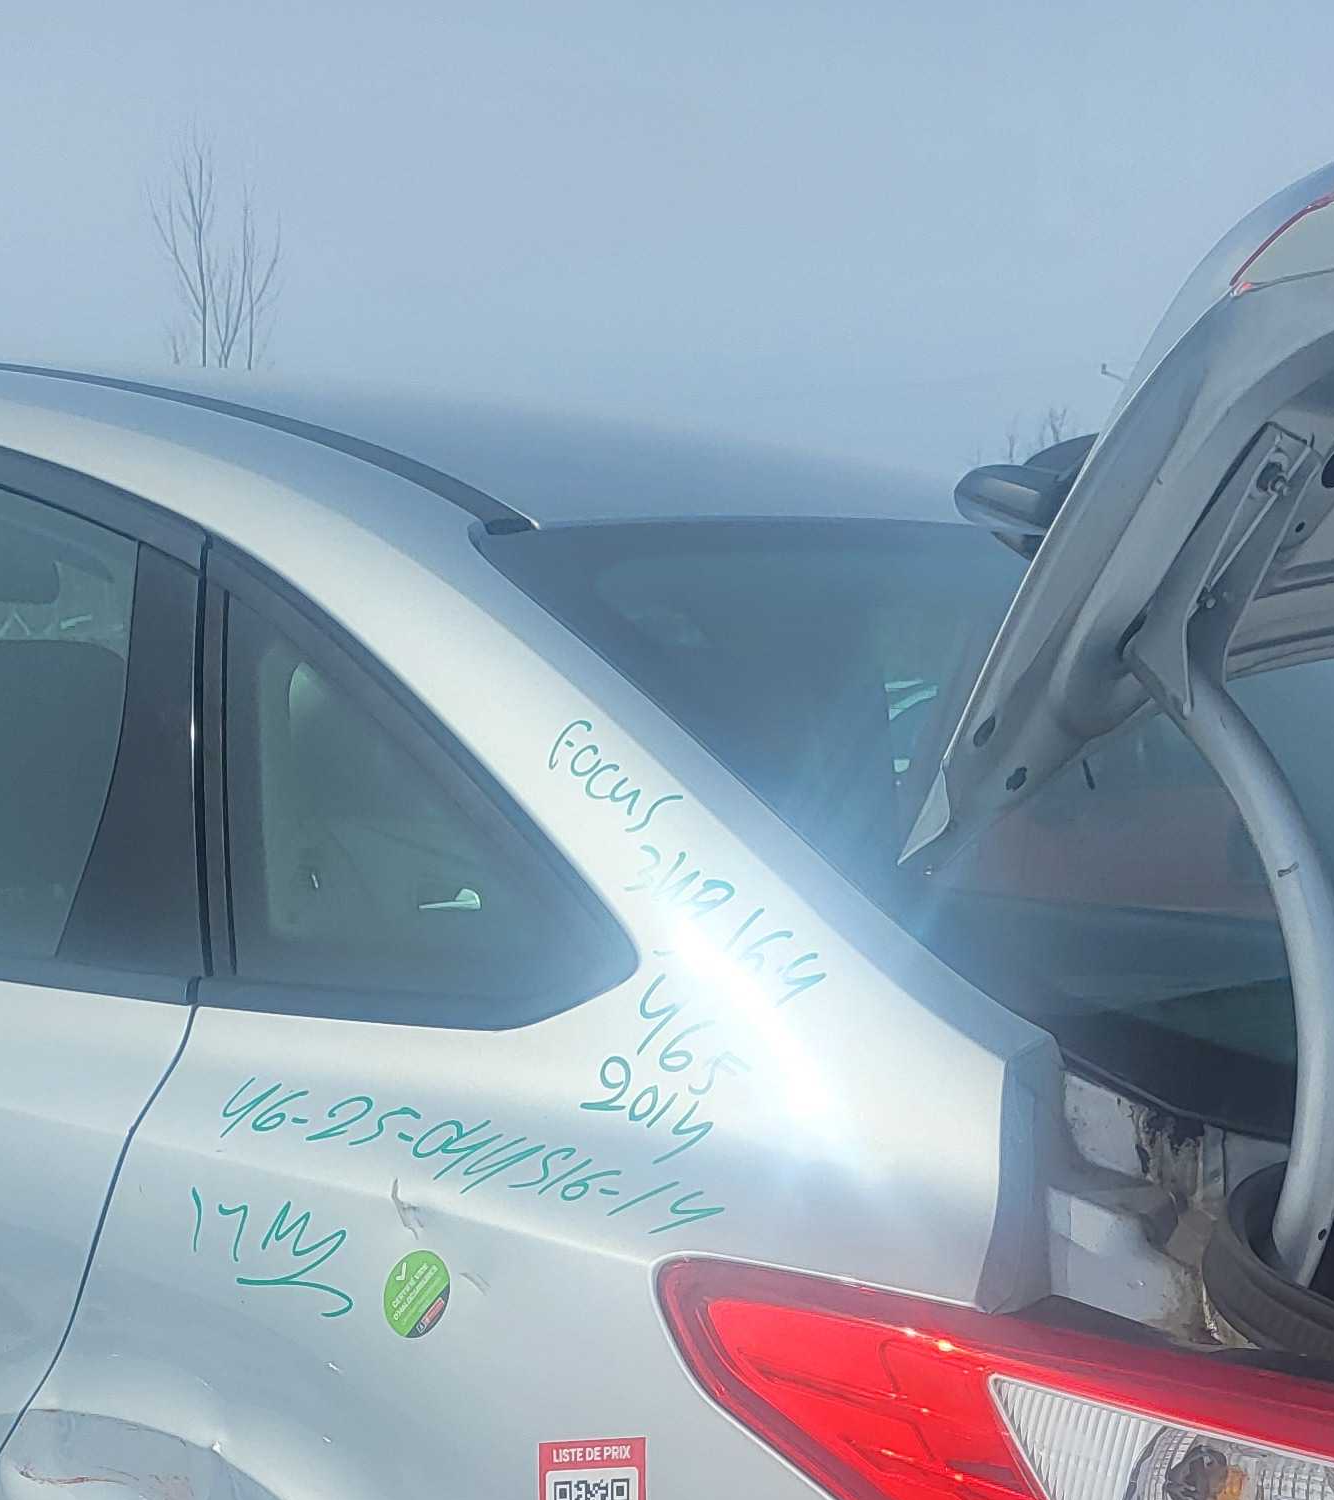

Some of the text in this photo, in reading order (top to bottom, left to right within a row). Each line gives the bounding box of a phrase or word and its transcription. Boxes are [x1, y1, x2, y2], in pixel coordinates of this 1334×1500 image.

[579, 1056, 714, 1165] 2014
[552, 1445, 631, 1463] LISTE DE PRIX
